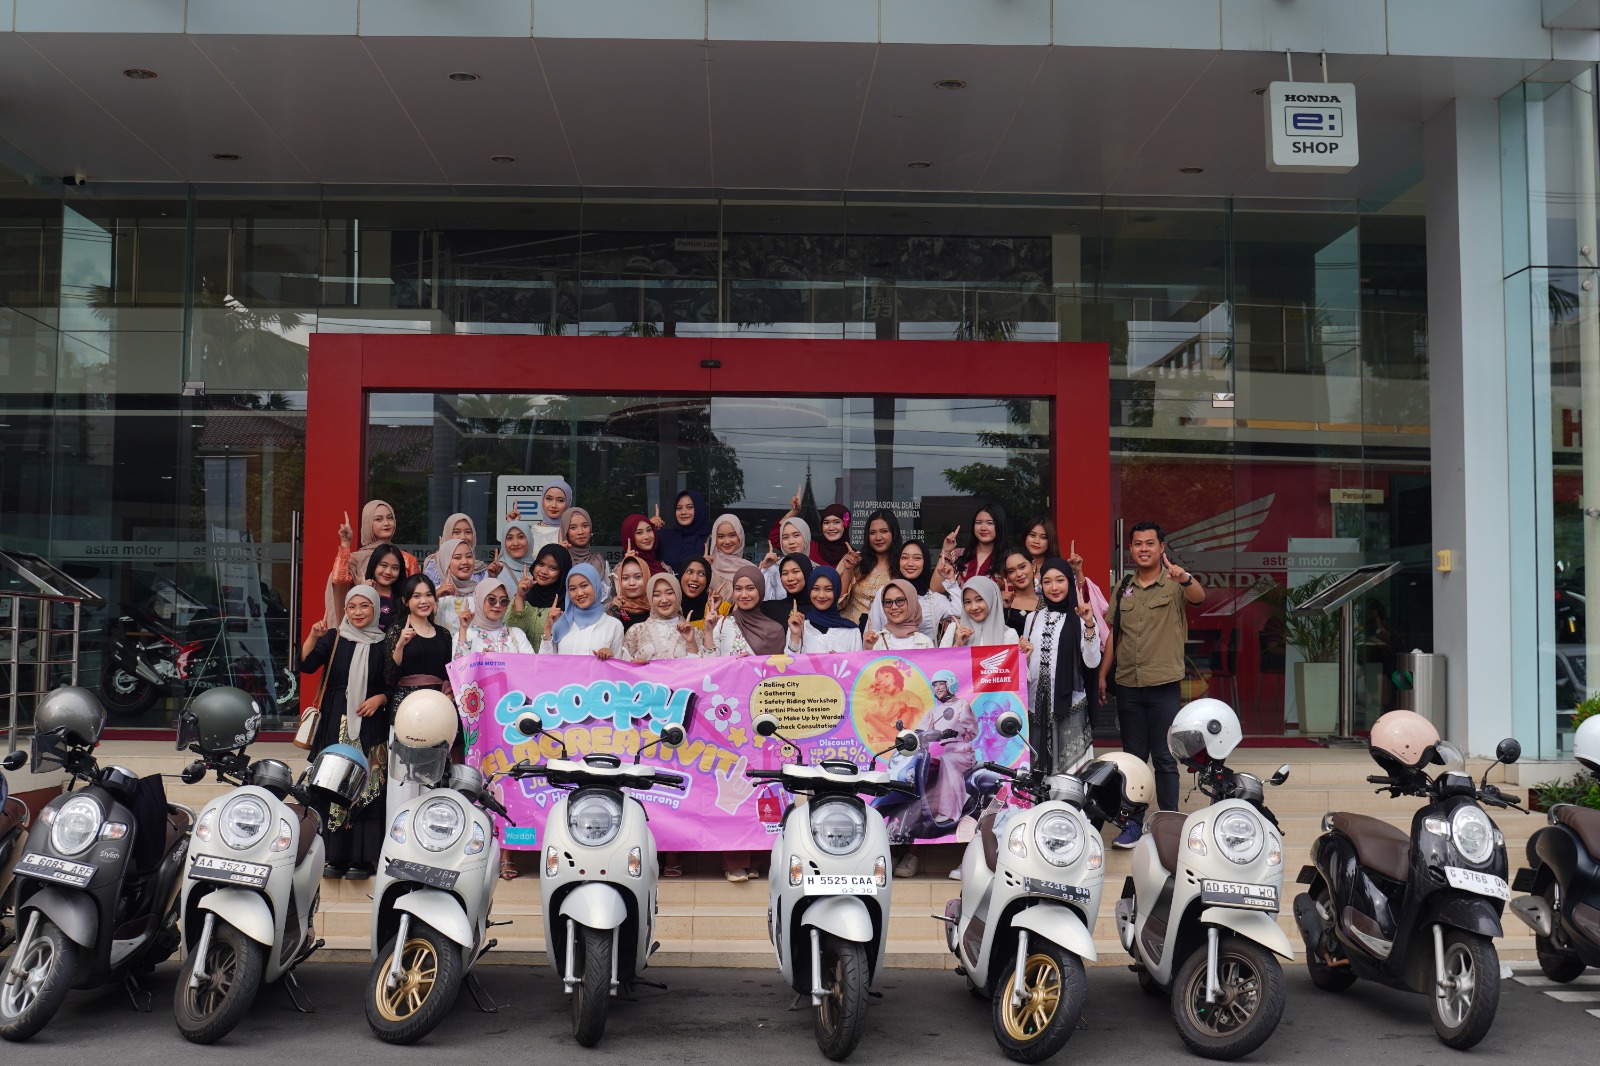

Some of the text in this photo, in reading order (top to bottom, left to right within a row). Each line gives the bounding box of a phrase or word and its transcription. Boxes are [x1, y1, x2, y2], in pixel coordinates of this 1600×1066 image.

[1284, 94, 1341, 103] HONDA
[1292, 112, 1336, 131] e:
[1292, 141, 1339, 154] SHOP
[677, 240, 703, 248] Premium
[865, 501, 901, 509] OPERASIONAL
[901, 501, 921, 510] DEALER
[85, 544, 164, 556] astra motor
[1262, 554, 1338, 566] astra motor
[1192, 572, 1276, 588] ONDA
[992, 676, 1012, 684] HEART
[796, 722, 838, 730] Consultation
[819, 739, 855, 747] Discount
[810, 746, 867, 765] up to 25%
[506, 832, 535, 840] Wardah
[100, 850, 120, 860] Stylish
[38, 857, 66, 870] 6085
[70, 865, 95, 876] ARF
[198, 858, 267, 876] AA 3523 YZ
[404, 862, 432, 875] 6427
[807, 876, 873, 885] H 5525 CAA
[1462, 870, 1488, 884] 5766
[1040, 880, 1067, 892] 2436
[1205, 882, 1220, 892] AD
[1223, 884, 1250, 895] 6570
